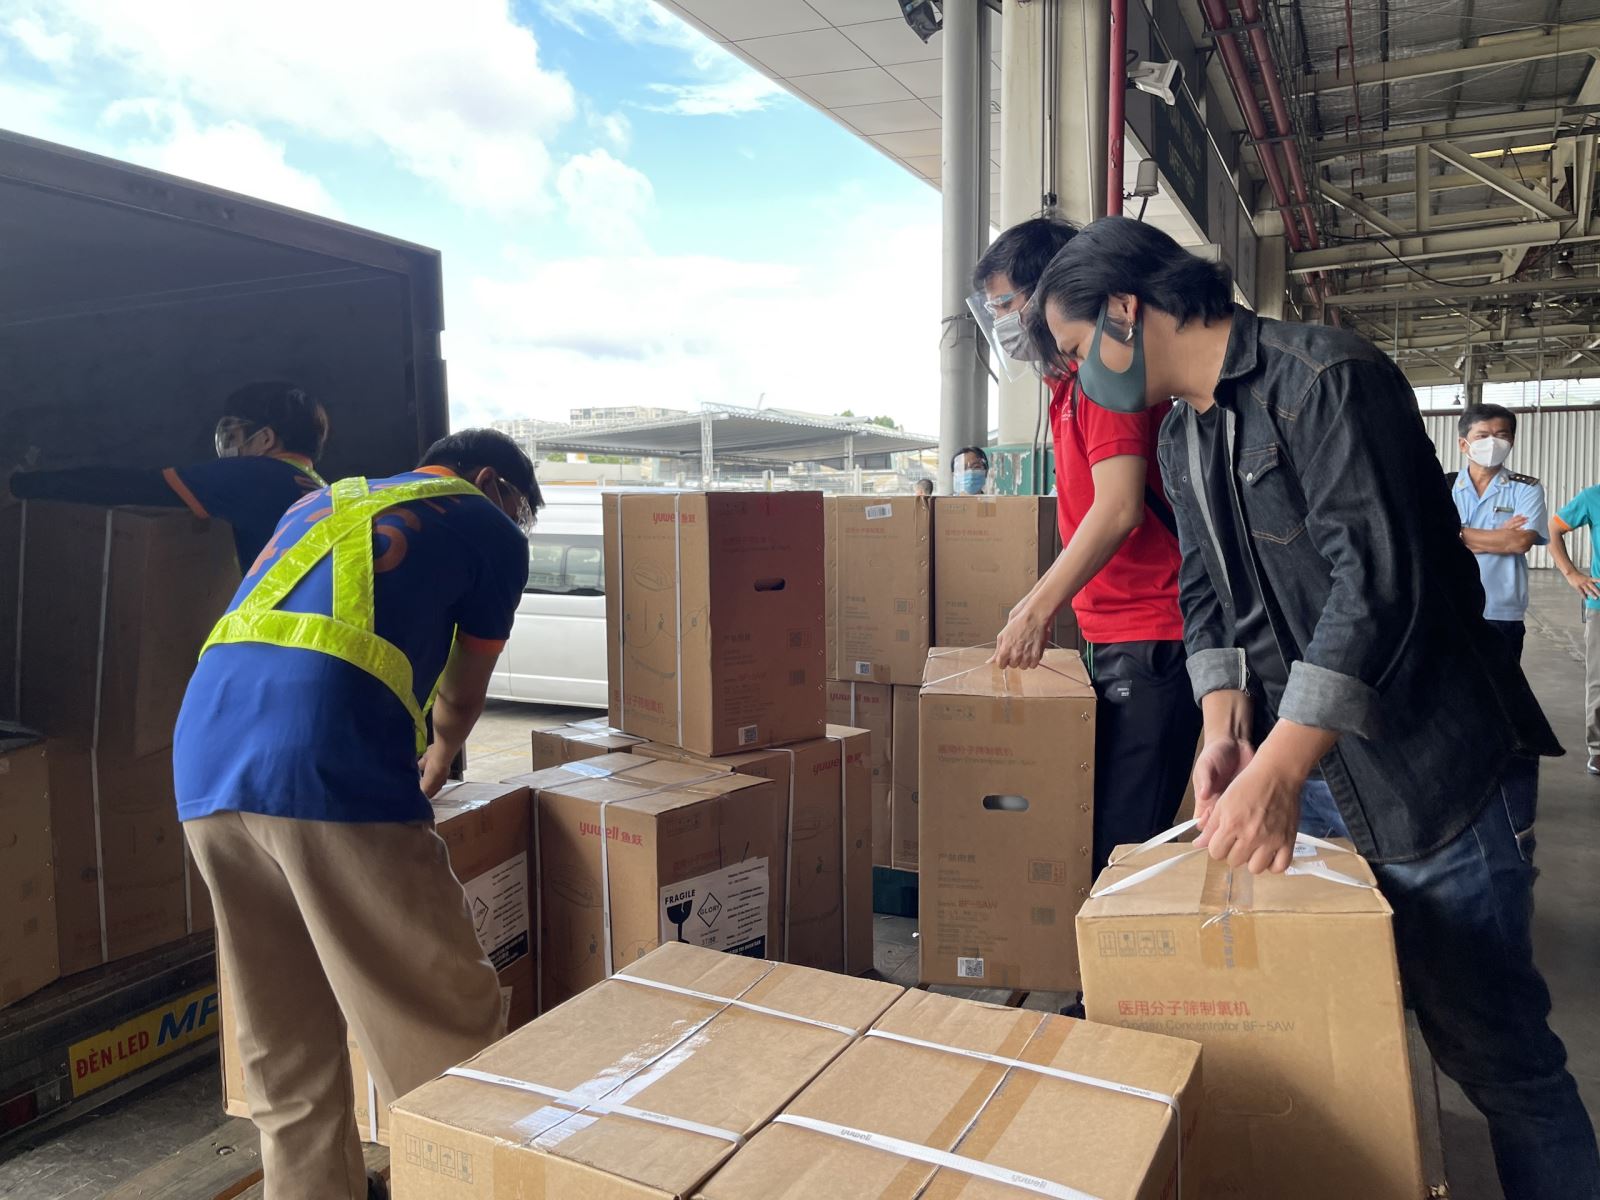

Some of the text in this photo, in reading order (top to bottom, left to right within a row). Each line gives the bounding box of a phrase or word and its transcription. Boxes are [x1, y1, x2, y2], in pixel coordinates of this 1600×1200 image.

[664, 889, 696, 905] FRAGILE
[699, 904, 721, 916] GLORY
[1165, 1018, 1240, 1032] Concentrator
[76, 1046, 113, 1080] ĐÈN
[118, 1031, 150, 1060] LED
